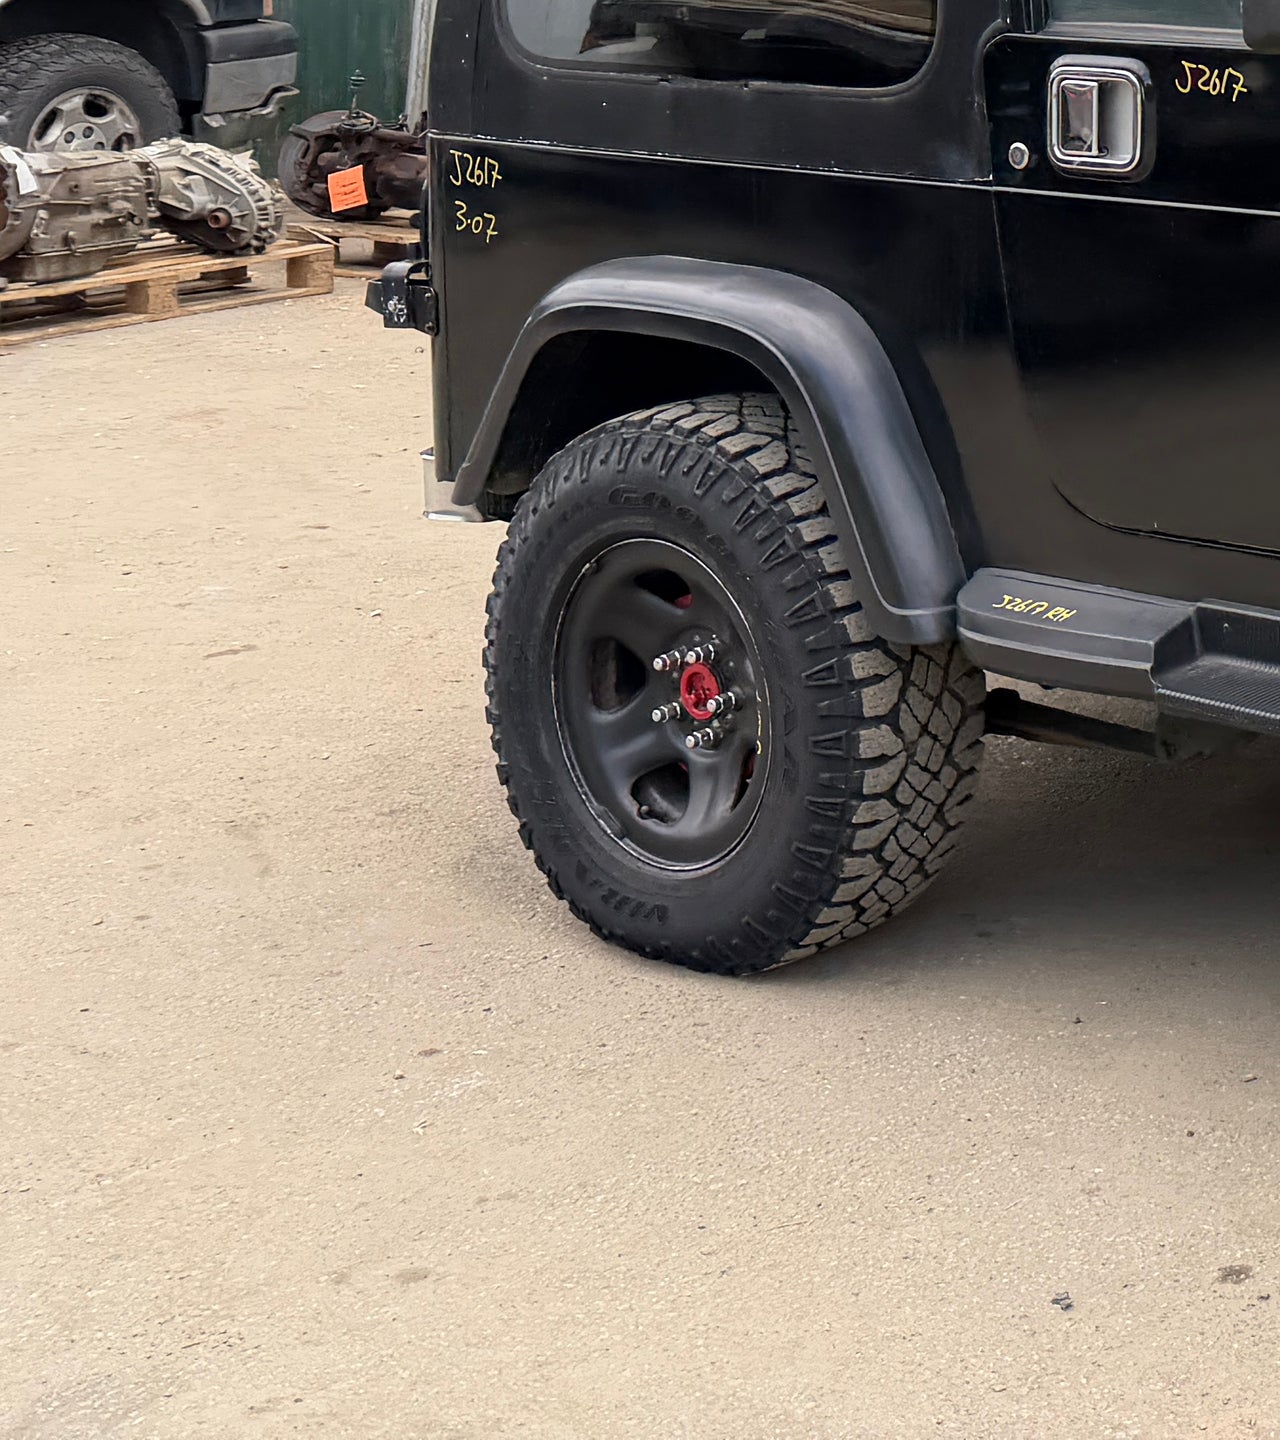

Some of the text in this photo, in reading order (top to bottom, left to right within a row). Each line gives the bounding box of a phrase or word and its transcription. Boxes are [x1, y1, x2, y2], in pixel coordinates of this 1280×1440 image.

[1175, 60, 1247, 102] J2617
[448, 149, 502, 188] J2617
[992, 594, 1077, 623] J2617 RH
